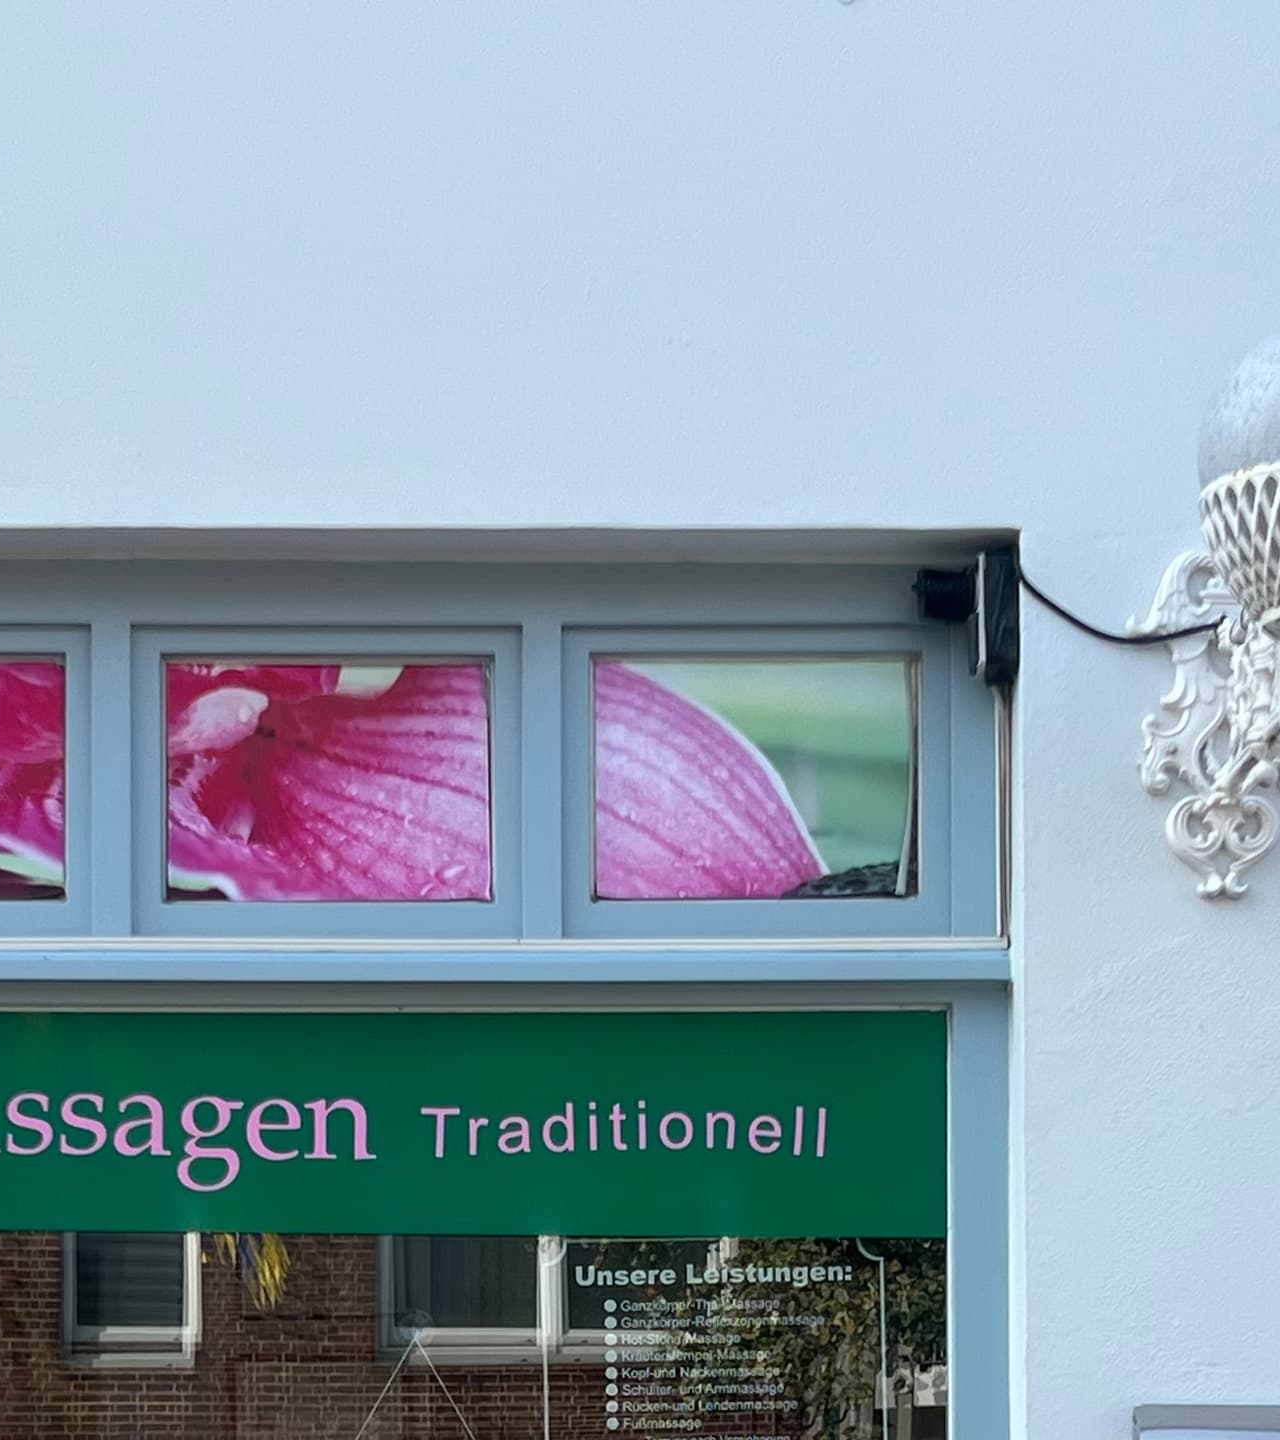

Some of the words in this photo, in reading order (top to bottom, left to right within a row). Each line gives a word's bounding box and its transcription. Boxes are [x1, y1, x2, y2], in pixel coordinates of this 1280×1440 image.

[421, 1100, 828, 1158] Traditionell
[575, 1265, 677, 1287] Unsere
[686, 1263, 853, 1288] Leistungen:
[623, 1417, 703, 1431] Fußmassage
